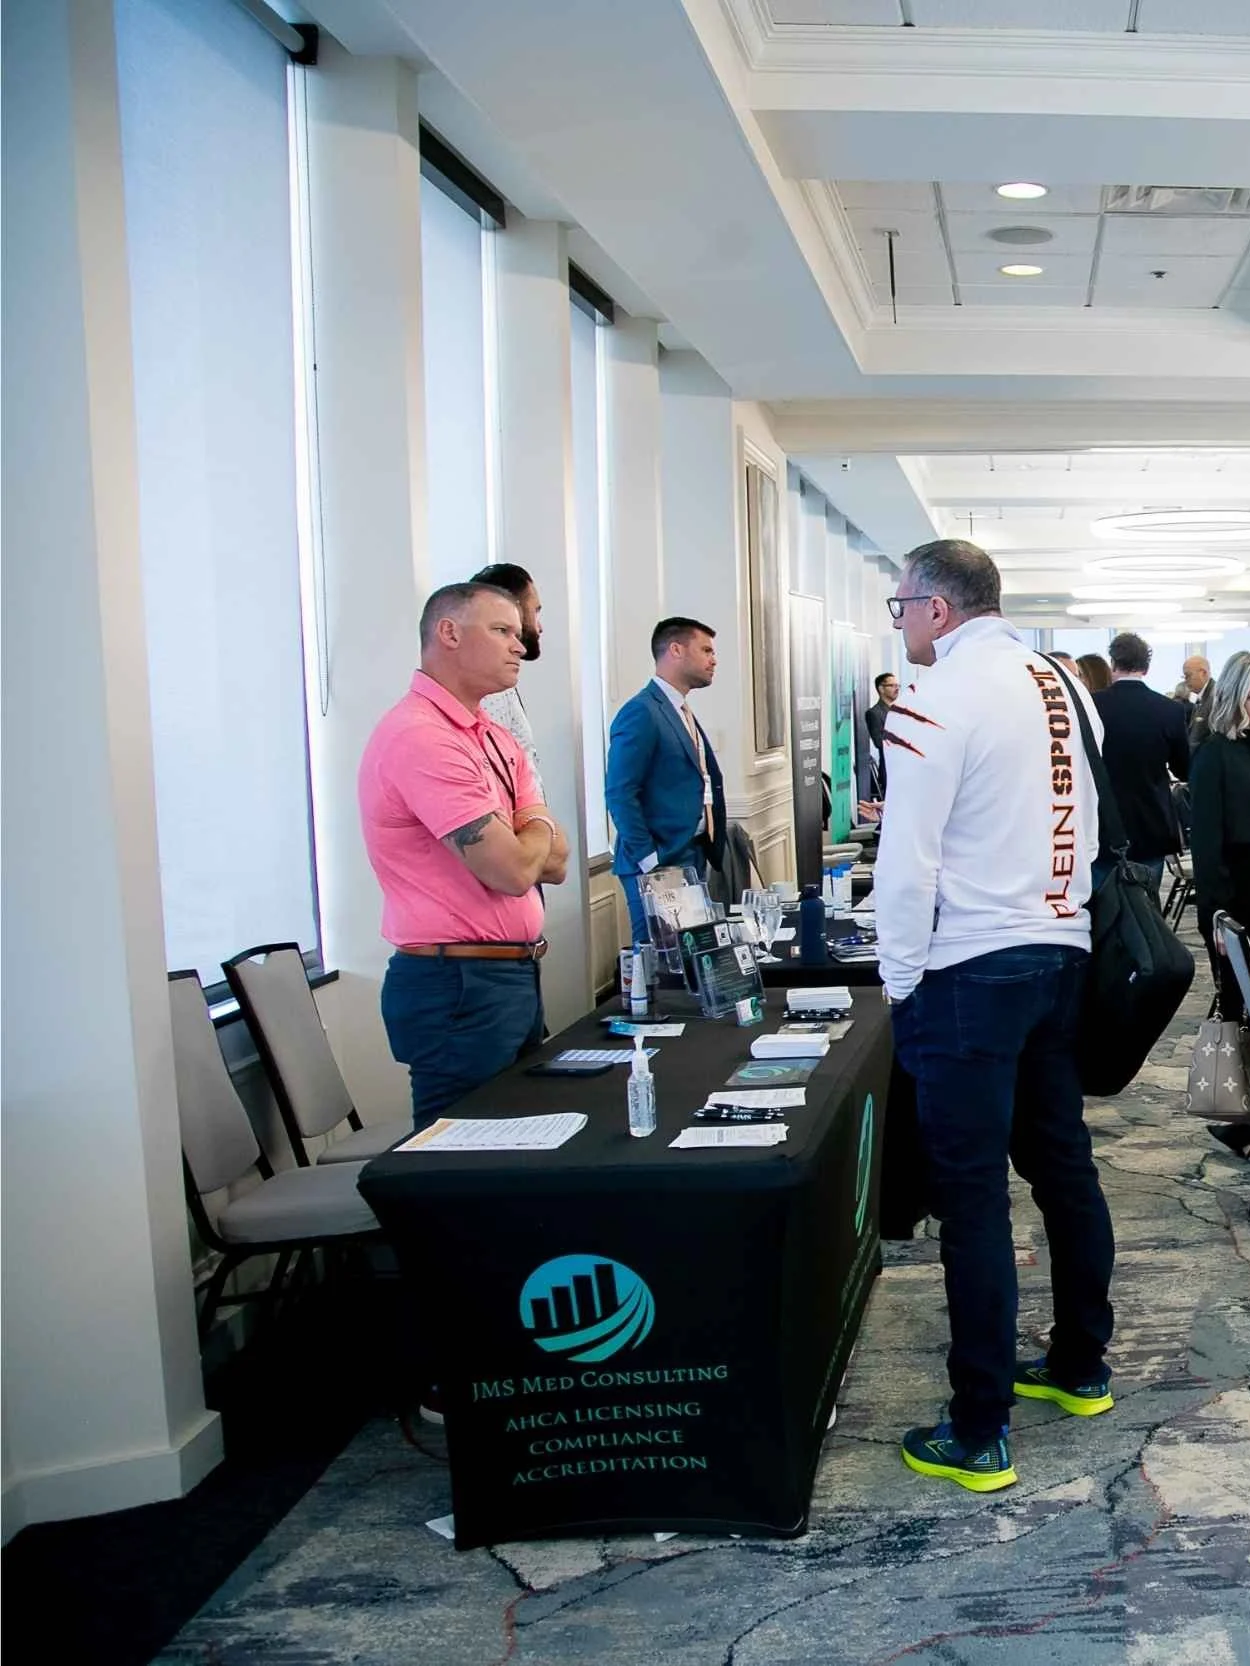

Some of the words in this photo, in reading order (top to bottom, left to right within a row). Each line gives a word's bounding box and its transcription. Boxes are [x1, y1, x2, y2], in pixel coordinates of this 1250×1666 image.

[471, 1379, 515, 1402] JMS
[505, 1411, 568, 1433] AHCA
[574, 1401, 702, 1424] LICENSING
[528, 1429, 685, 1456] COMPLIANCE
[511, 1455, 709, 1486] ACCREDITATION
